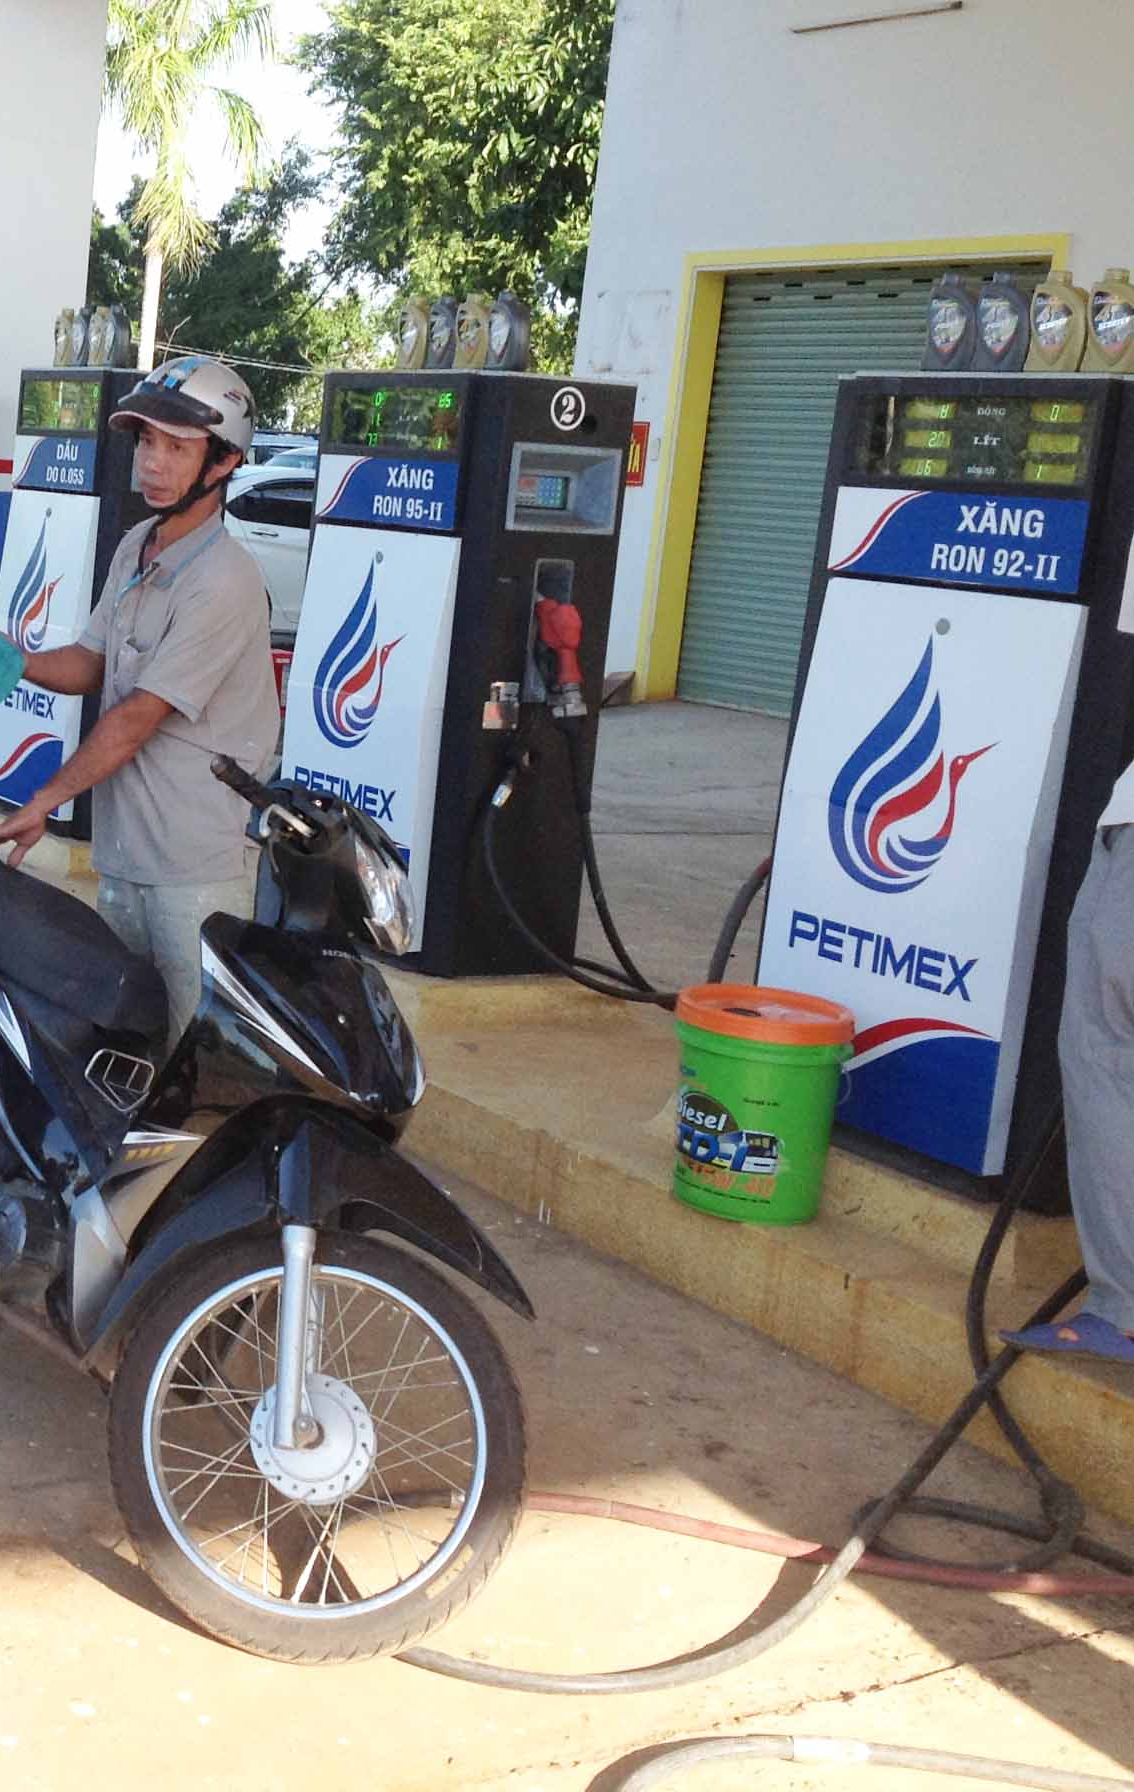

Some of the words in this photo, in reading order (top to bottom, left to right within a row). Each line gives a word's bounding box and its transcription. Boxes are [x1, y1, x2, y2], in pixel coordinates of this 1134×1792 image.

[559, 394, 576, 423] 2
[56, 439, 79, 463] DẦU
[46, 466, 59, 483] DO
[60, 467, 85, 486] 0.05S
[385, 465, 435, 491] XĂNG
[372, 497, 402, 518] RON
[405, 499, 442, 522] 95-II
[957, 501, 1046, 539] XĂNG
[930, 543, 986, 575] RON
[992, 548, 1061, 581] 92-II
[4, 686, 56, 720] ETIMEX
[788, 910, 978, 1002] PETIMEX
